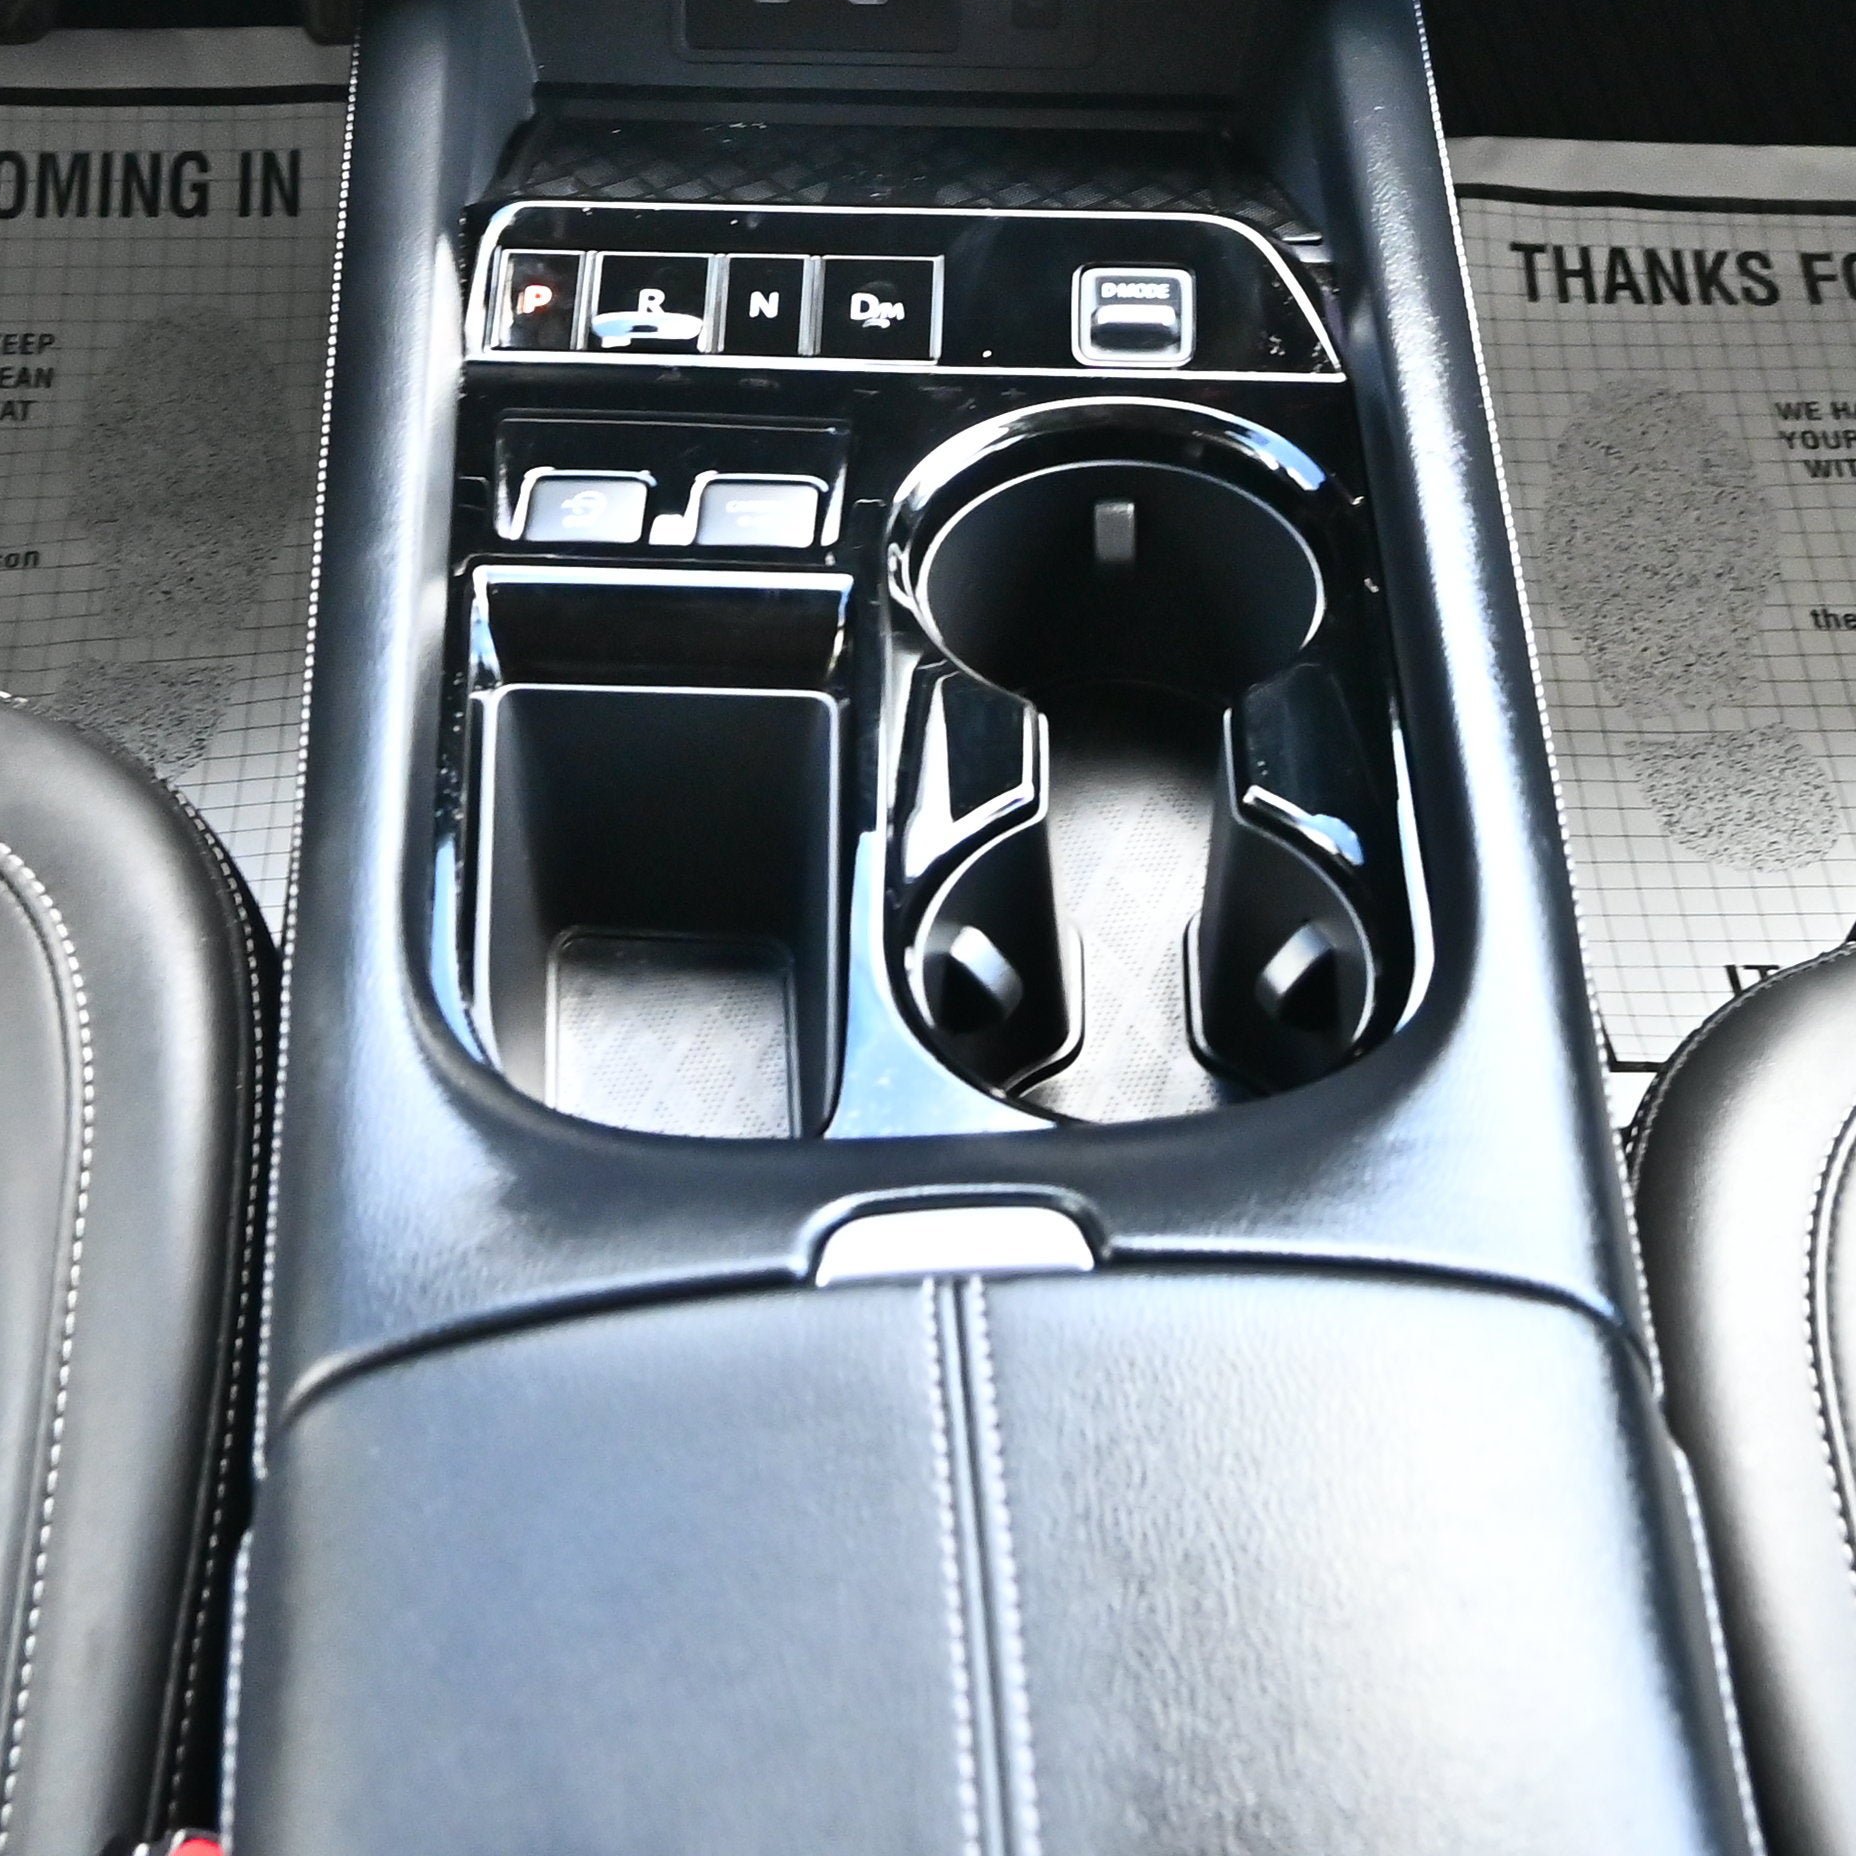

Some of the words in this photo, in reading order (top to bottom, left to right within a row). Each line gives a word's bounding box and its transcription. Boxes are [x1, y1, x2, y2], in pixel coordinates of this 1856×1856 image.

[238, 149, 301, 218] IN
[1510, 241, 1780, 306] THANKS
[520, 284, 553, 314] P
[638, 288, 666, 313] R
[749, 291, 780, 318] N
[1775, 401, 1822, 420] WE
